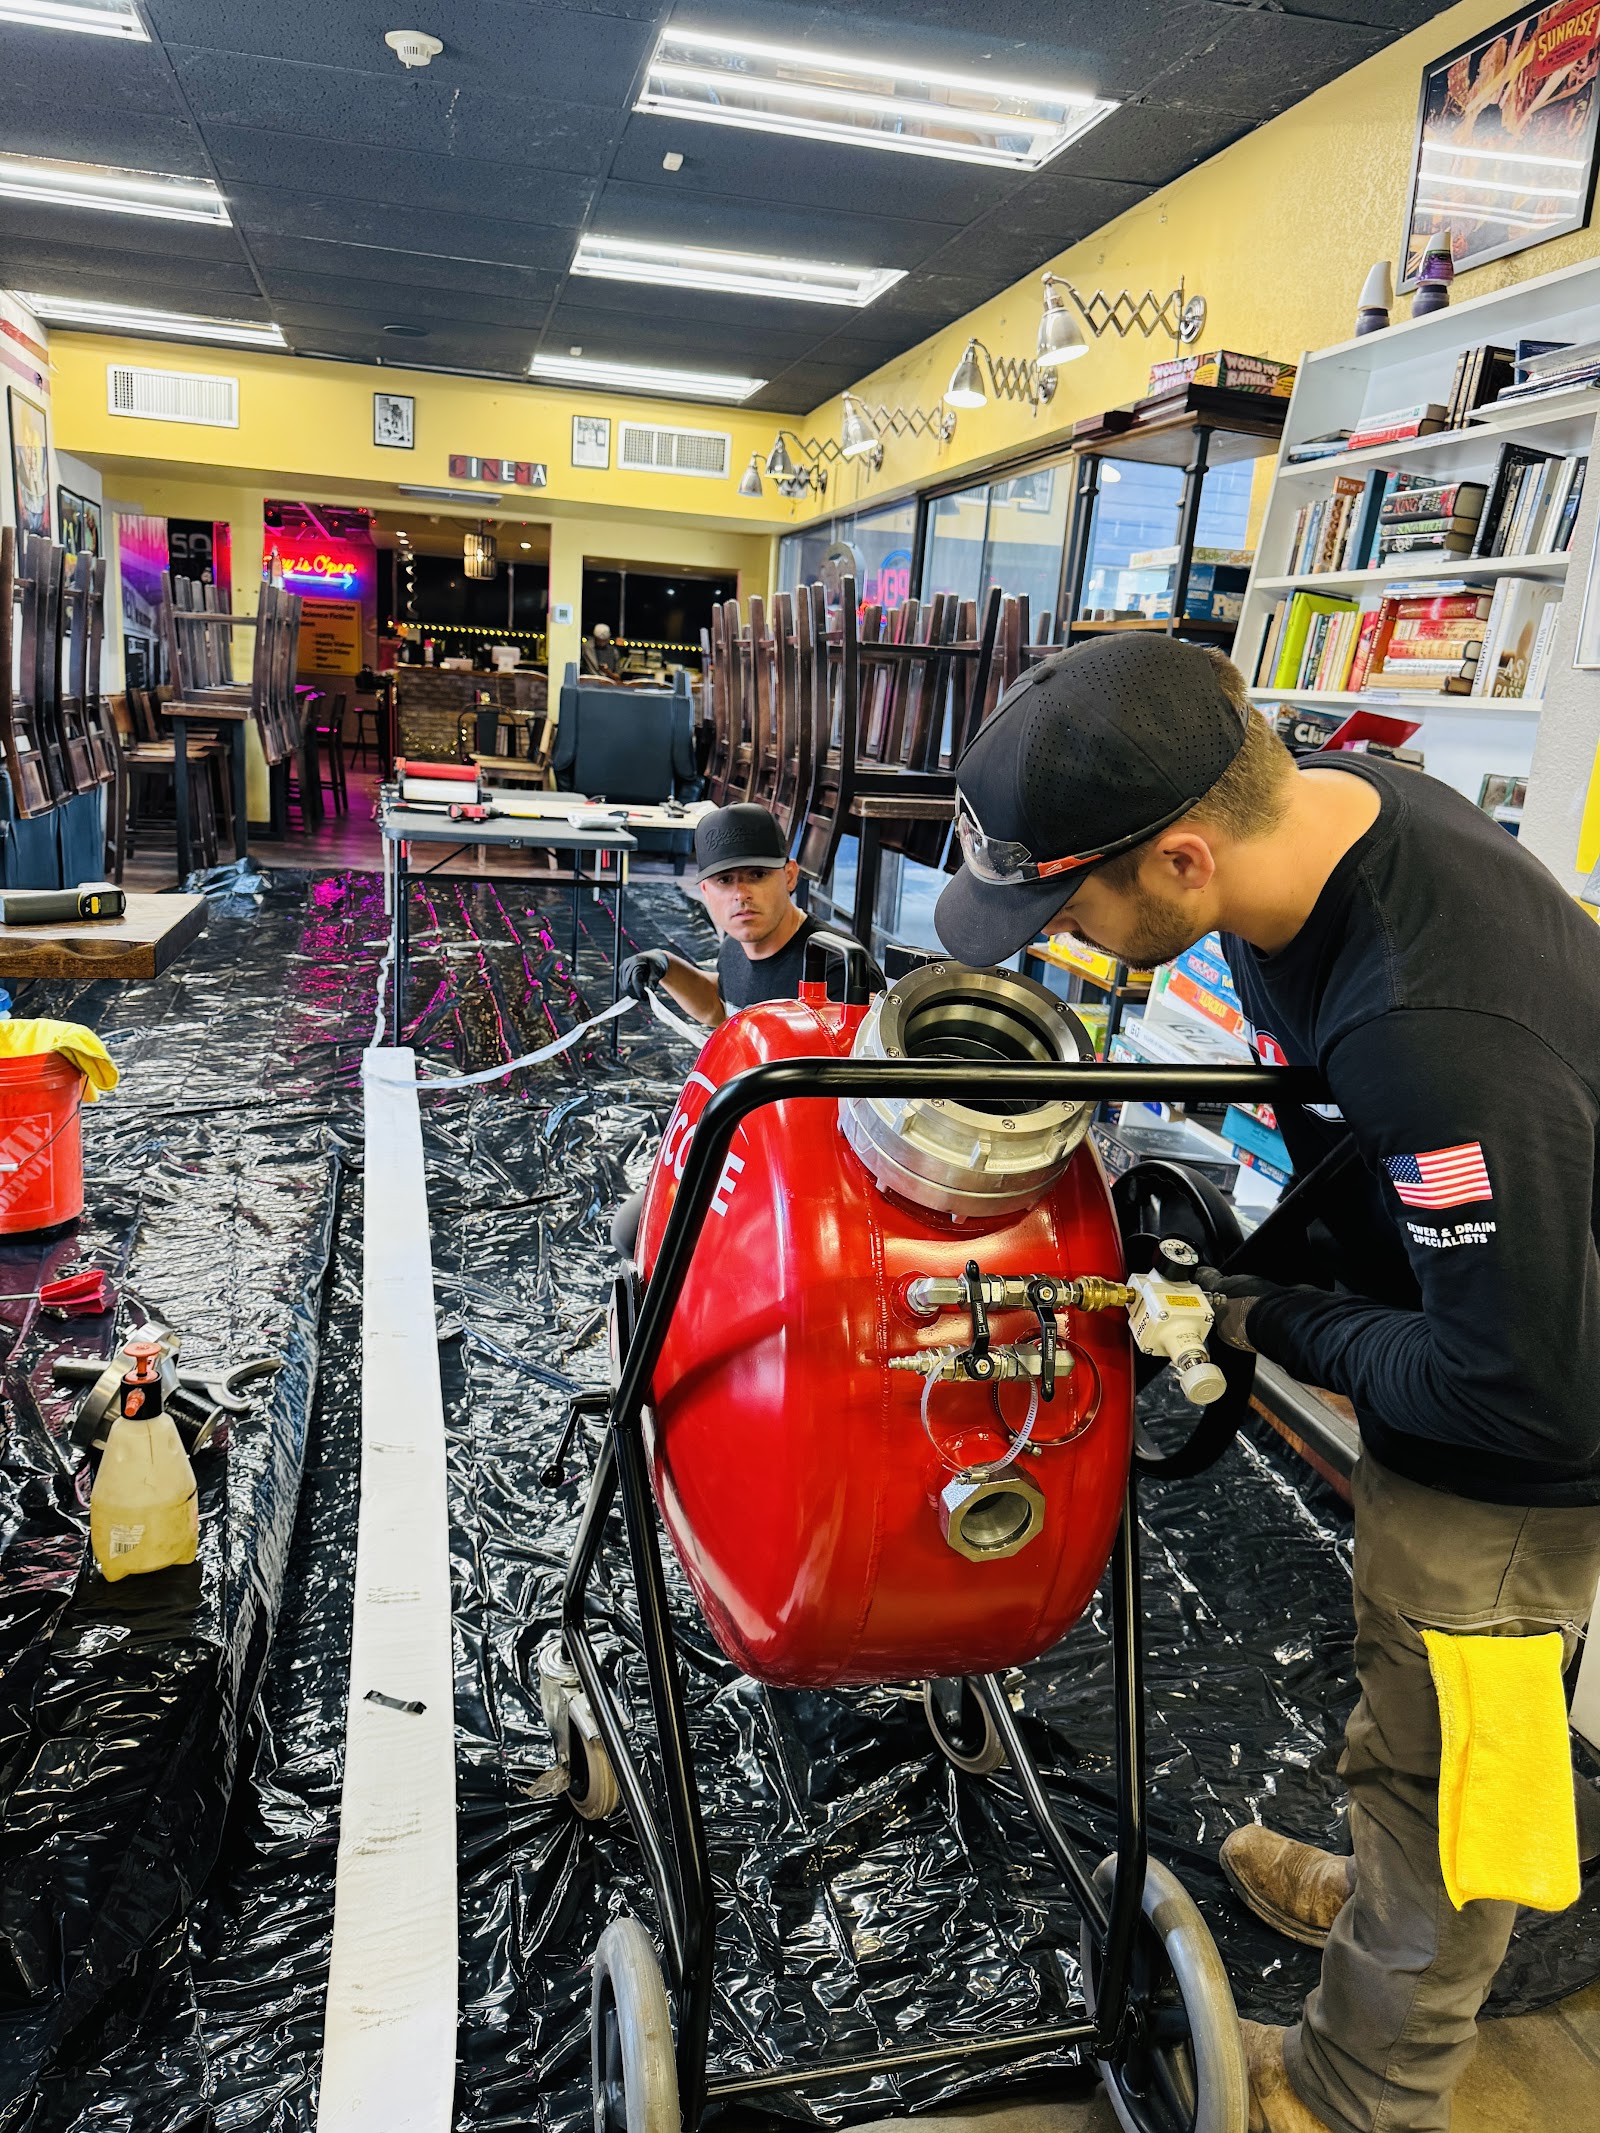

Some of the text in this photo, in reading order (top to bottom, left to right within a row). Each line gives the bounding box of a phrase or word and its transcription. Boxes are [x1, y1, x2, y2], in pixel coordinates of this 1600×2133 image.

[1538, 3, 1600, 61] SUNRISE
[1223, 353, 1281, 377] WOULD YOU
[449, 456, 547, 486] CINEMA
[313, 555, 358, 578] Open
[1474, 629, 1492, 685] CHAMPION
[1504, 657, 1525, 678] AS
[1406, 1221, 1497, 1238] SEWER & DRAIN
[1412, 1233, 1489, 1248] SPECIALISTS
[976, 1302, 984, 1324] MERCURY
